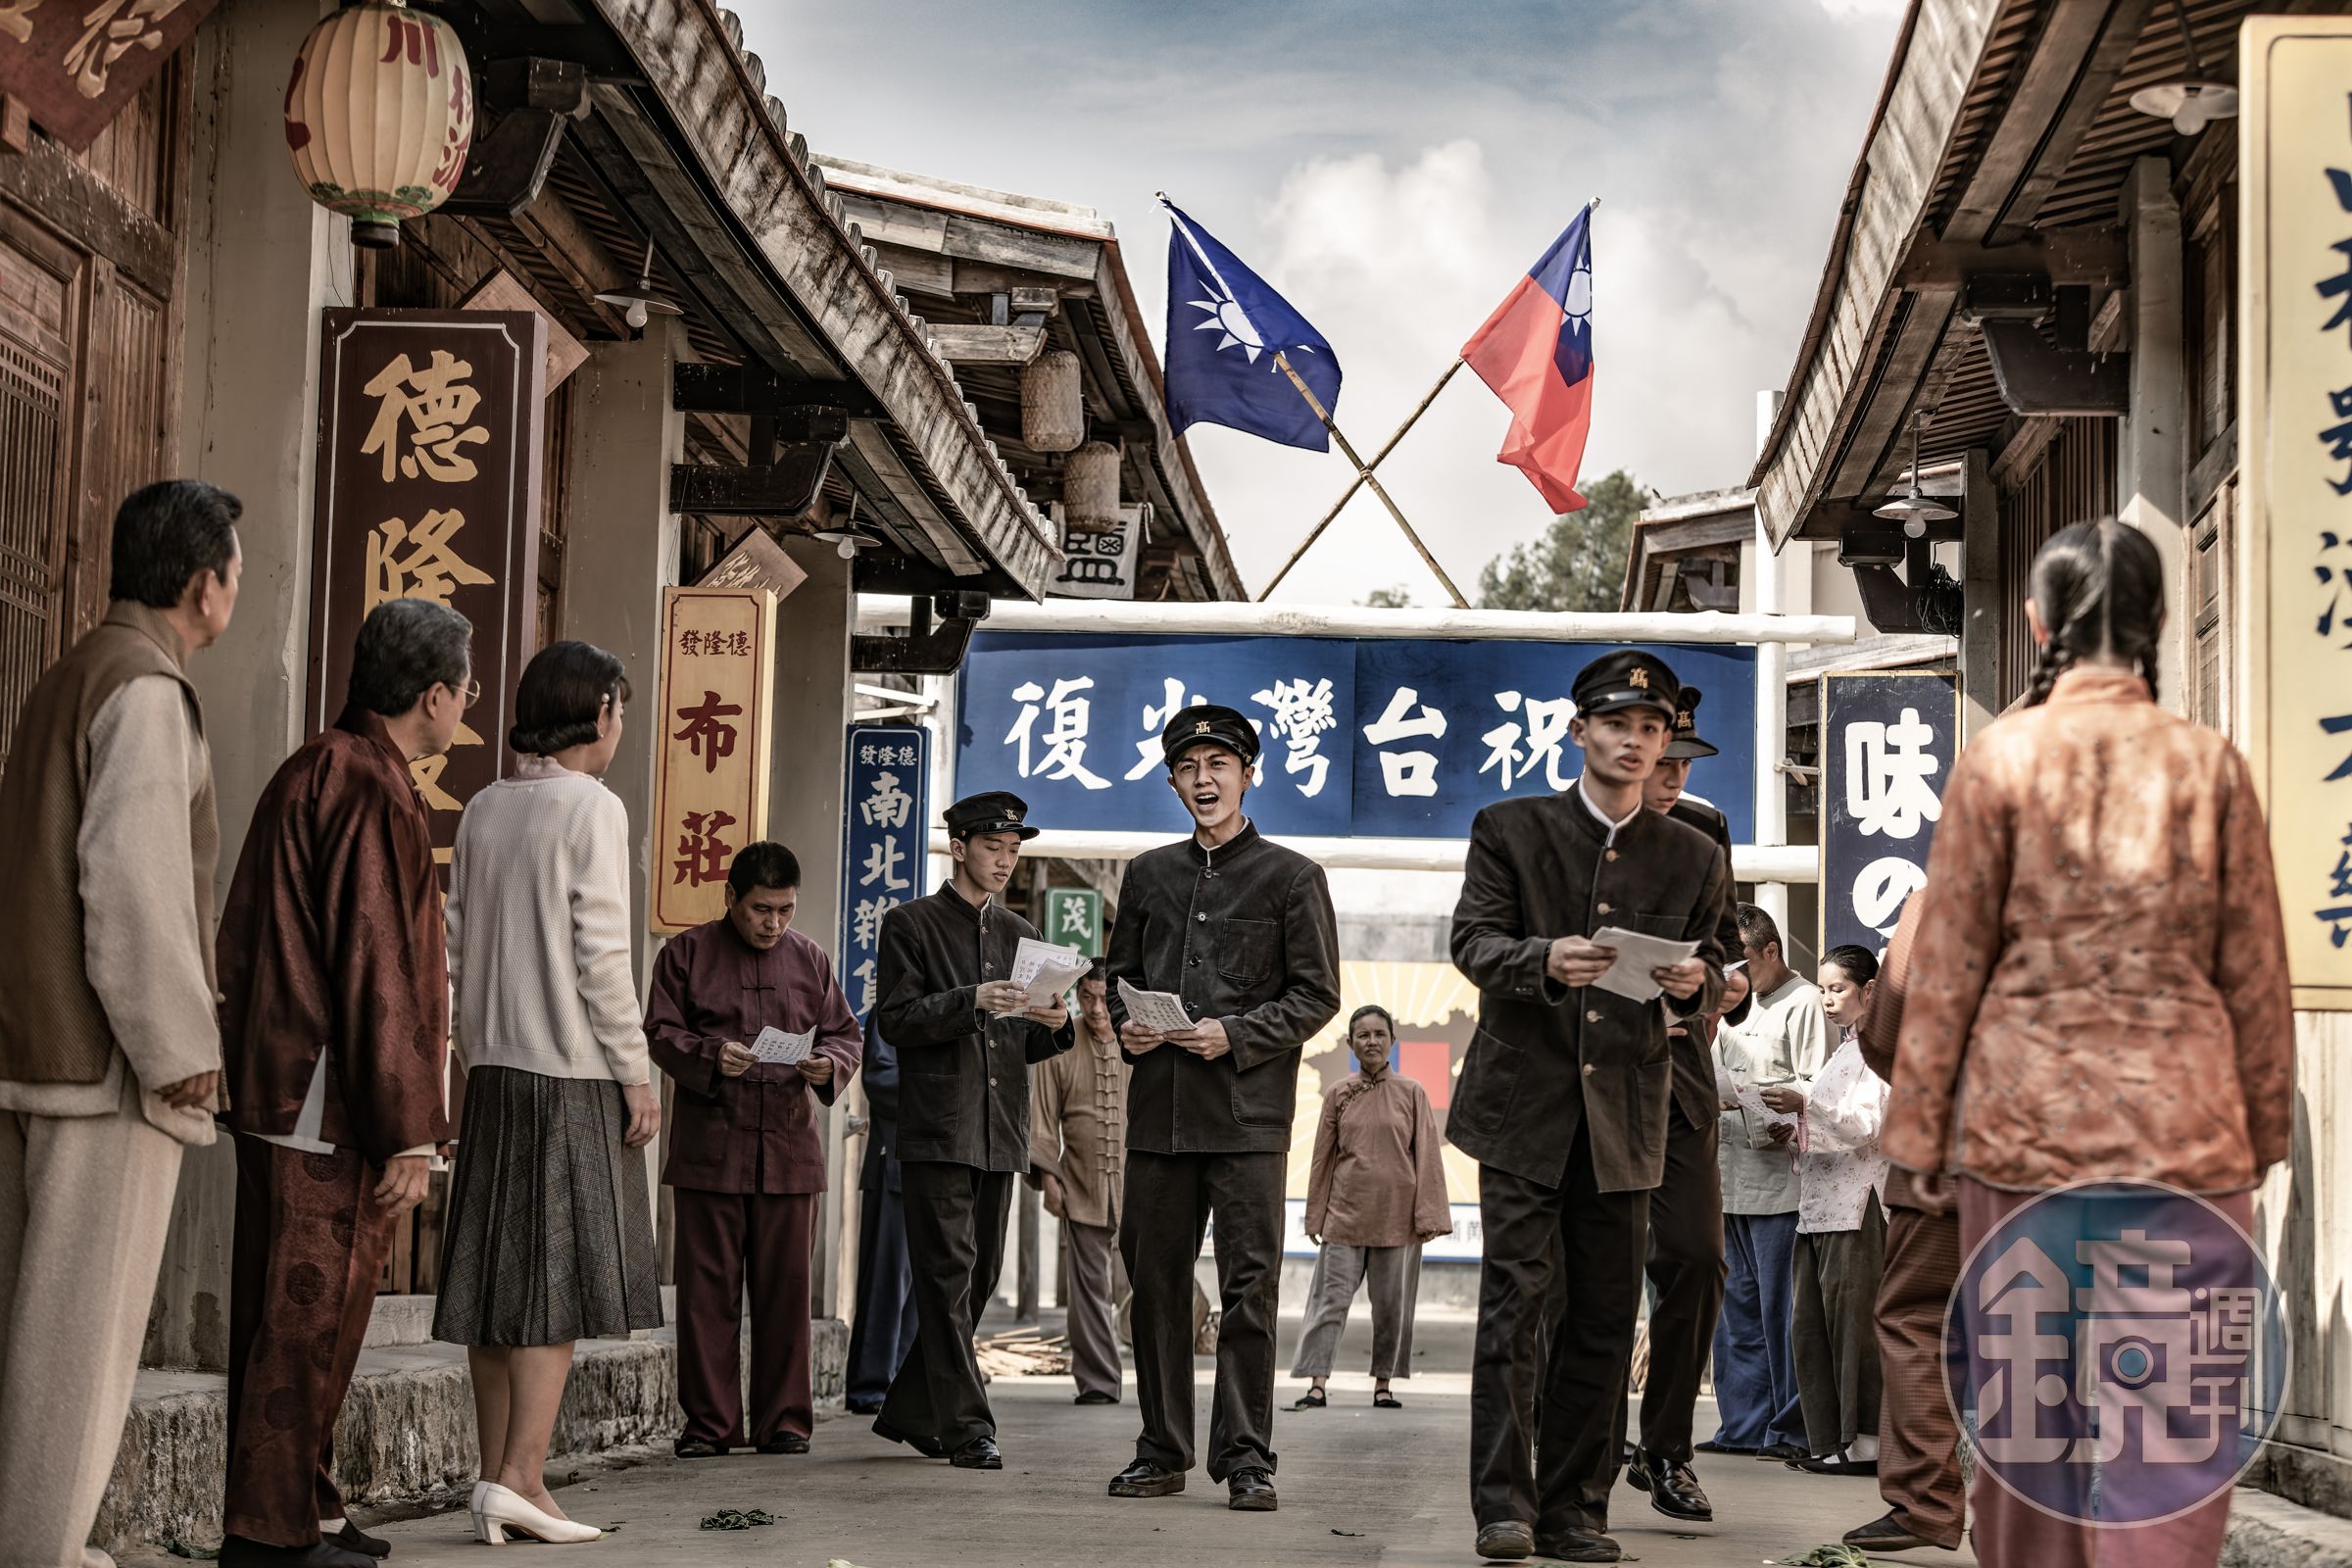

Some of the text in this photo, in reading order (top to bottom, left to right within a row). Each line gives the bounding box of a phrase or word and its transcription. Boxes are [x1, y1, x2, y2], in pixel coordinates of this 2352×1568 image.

[678, 629, 752, 658] 德隆發
[673, 690, 743, 888] 布莊
[859, 745, 917, 767] 德隆發
[1845, 708, 1943, 965] 味の
